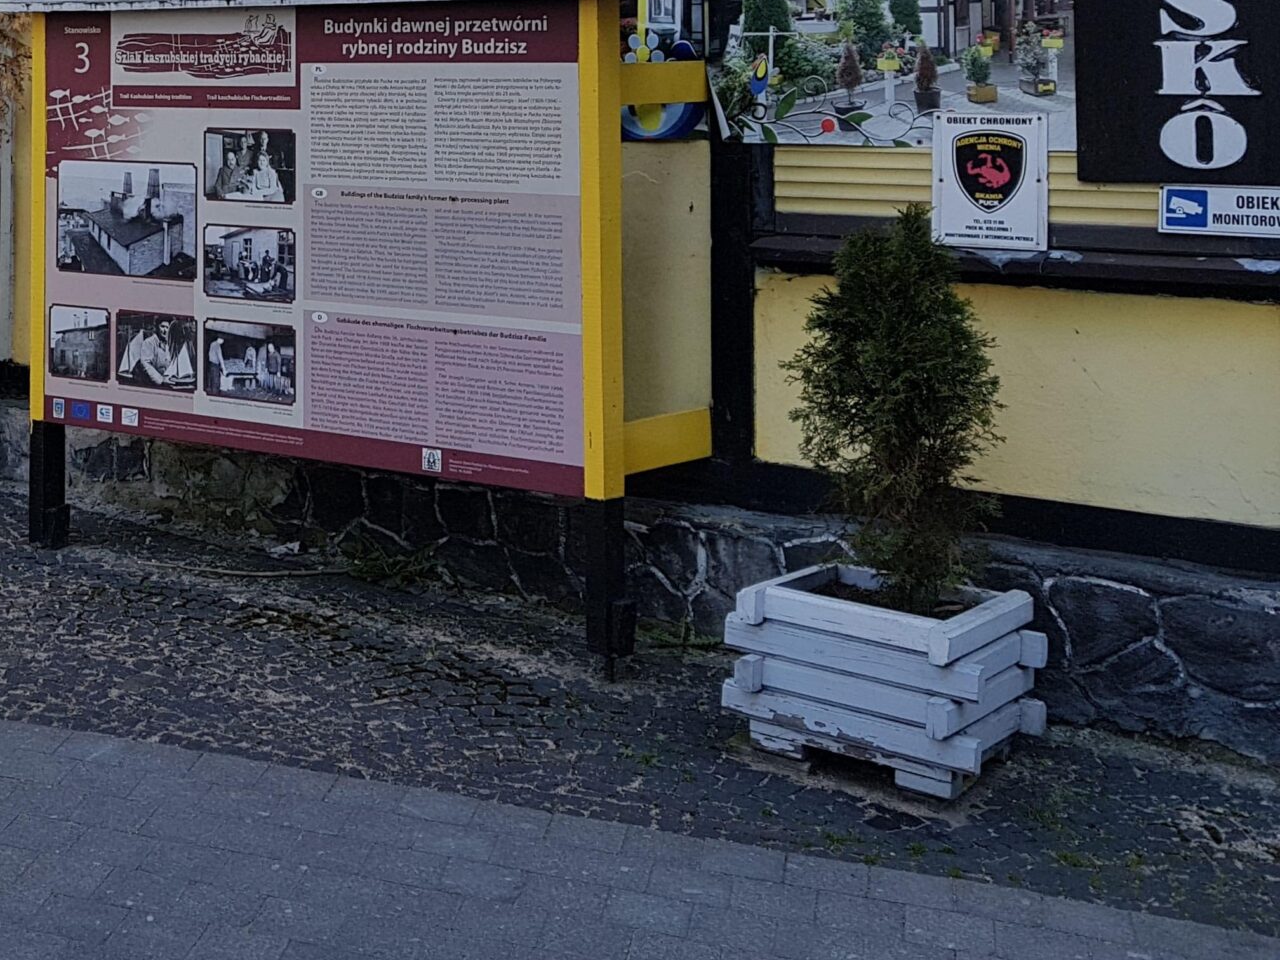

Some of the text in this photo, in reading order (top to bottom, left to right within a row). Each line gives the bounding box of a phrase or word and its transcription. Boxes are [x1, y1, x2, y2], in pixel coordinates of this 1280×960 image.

[64, 26, 101, 34] Stanowisko
[324, 15, 548, 37] Budynki dawnej przetwórni
[342, 38, 528, 58] rybnej rodziny Budzisz
[74, 42, 90, 74] 3
[115, 51, 286, 66] Szlak kaszubskiej tradycji rybackiej
[946, 116, 1033, 126] OBIEKT CHRONIONY
[956, 136, 1023, 149] AGENCJA OCHRONY
[340, 190, 365, 199] Buildings
[460, 196, 492, 205] processing
[493, 197, 509, 205] plant
[978, 199, 1000, 207] PUCK
